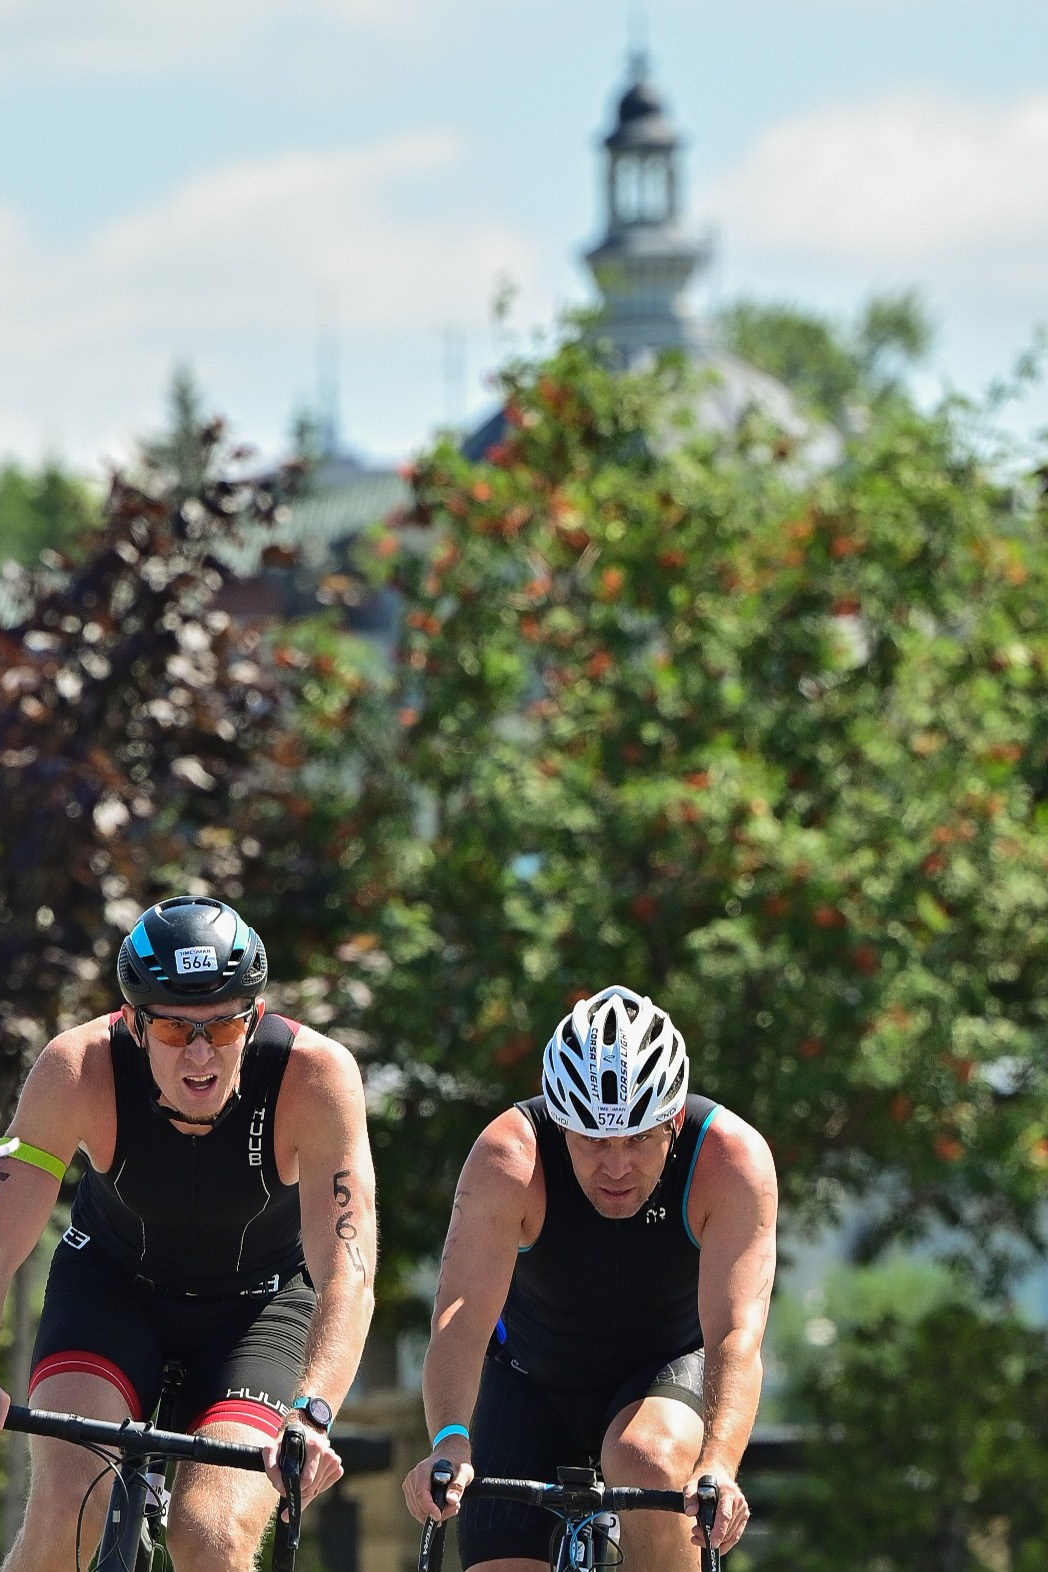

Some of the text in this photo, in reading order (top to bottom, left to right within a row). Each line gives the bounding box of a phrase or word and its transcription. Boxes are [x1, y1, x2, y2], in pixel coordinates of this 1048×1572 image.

[182, 955, 212, 970] 564
[589, 1027, 601, 1101] CORSA LIGHT
[619, 1027, 629, 1103] CORSA LIGHT
[248, 1107, 266, 1167] HUUB
[598, 1112, 625, 1126] 574
[333, 1169, 367, 1285] 564
